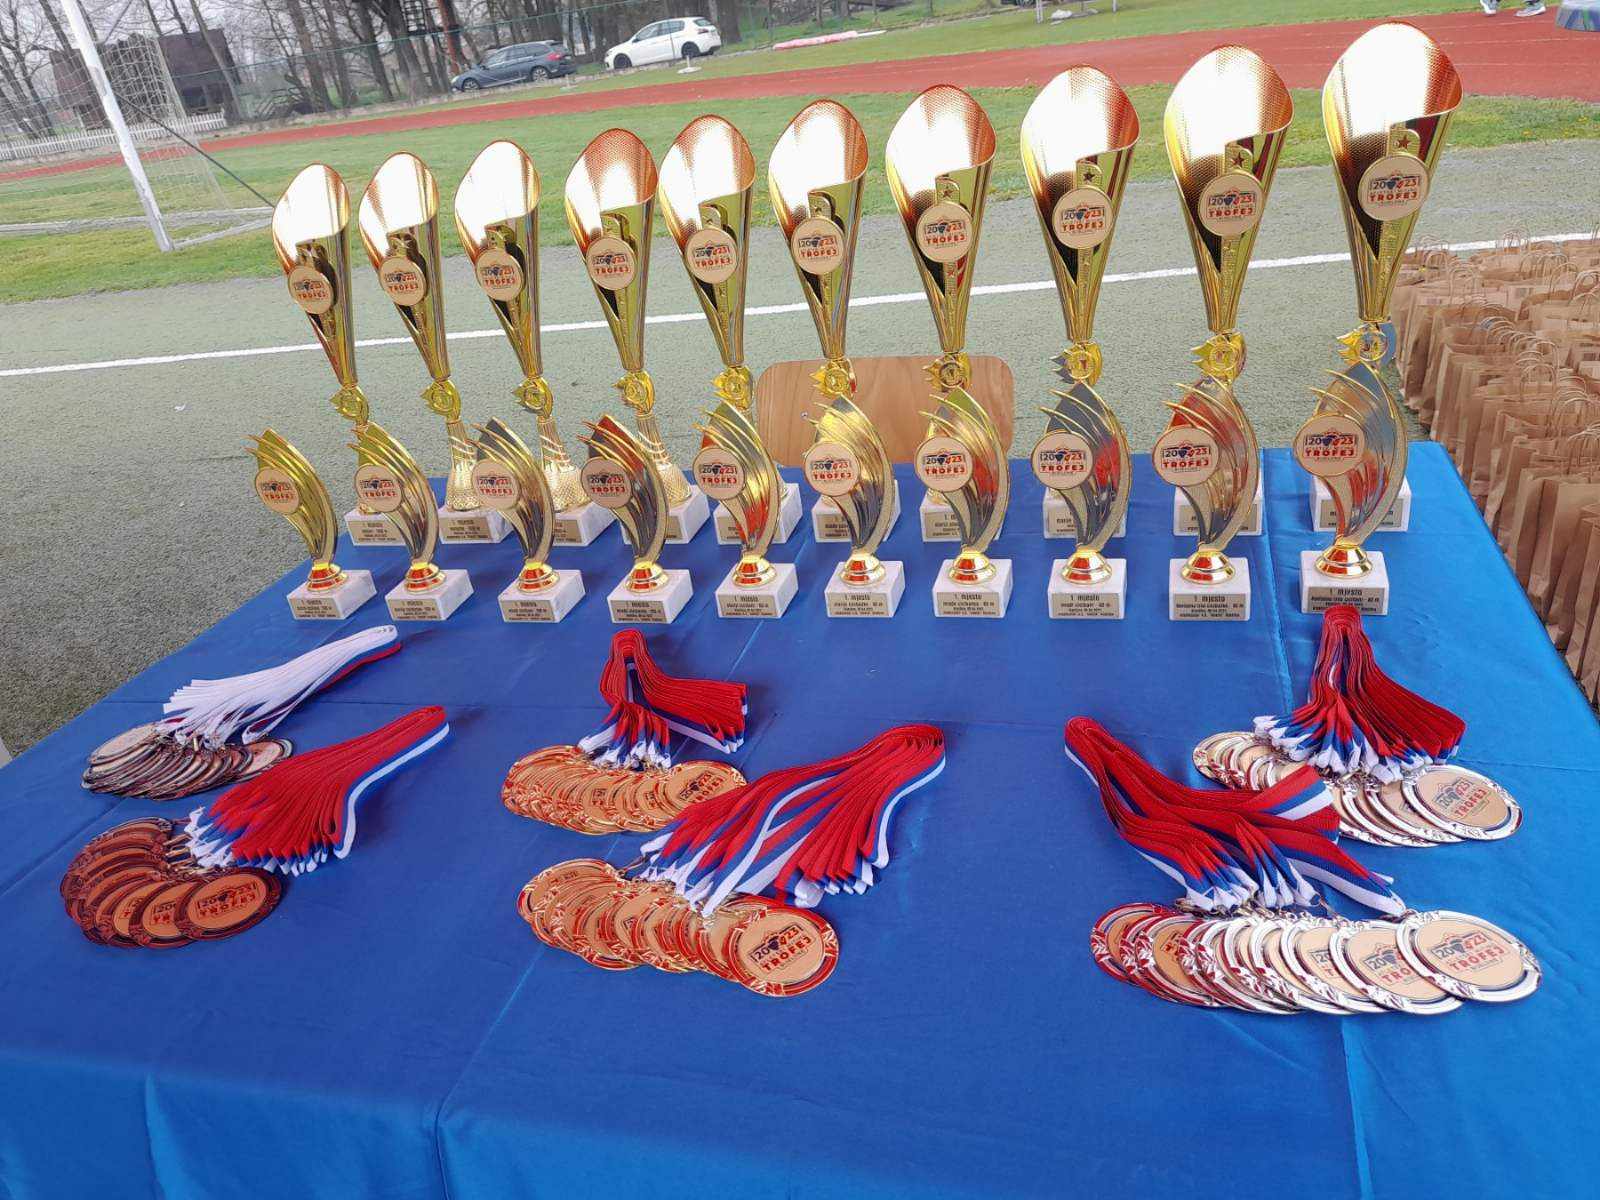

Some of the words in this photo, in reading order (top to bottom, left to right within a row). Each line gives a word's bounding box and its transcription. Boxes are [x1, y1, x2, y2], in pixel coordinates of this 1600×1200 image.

[1370, 192, 1417, 201] TROFEJ
[1209, 208, 1252, 217] TROFEJ
[1063, 222, 1103, 231] TROFEJ
[927, 236, 964, 244] TROFEJ
[801, 249, 836, 257] TROFEJ
[1163, 460, 1208, 468] TROFEJ
[814, 472, 851, 480] TROFEJ
[1455, 789, 1488, 817] TROFEJ
[200, 893, 255, 916] TROFEJ
[763, 936, 811, 971] TROFEJ
[1451, 946, 1505, 971] TROFEJ
